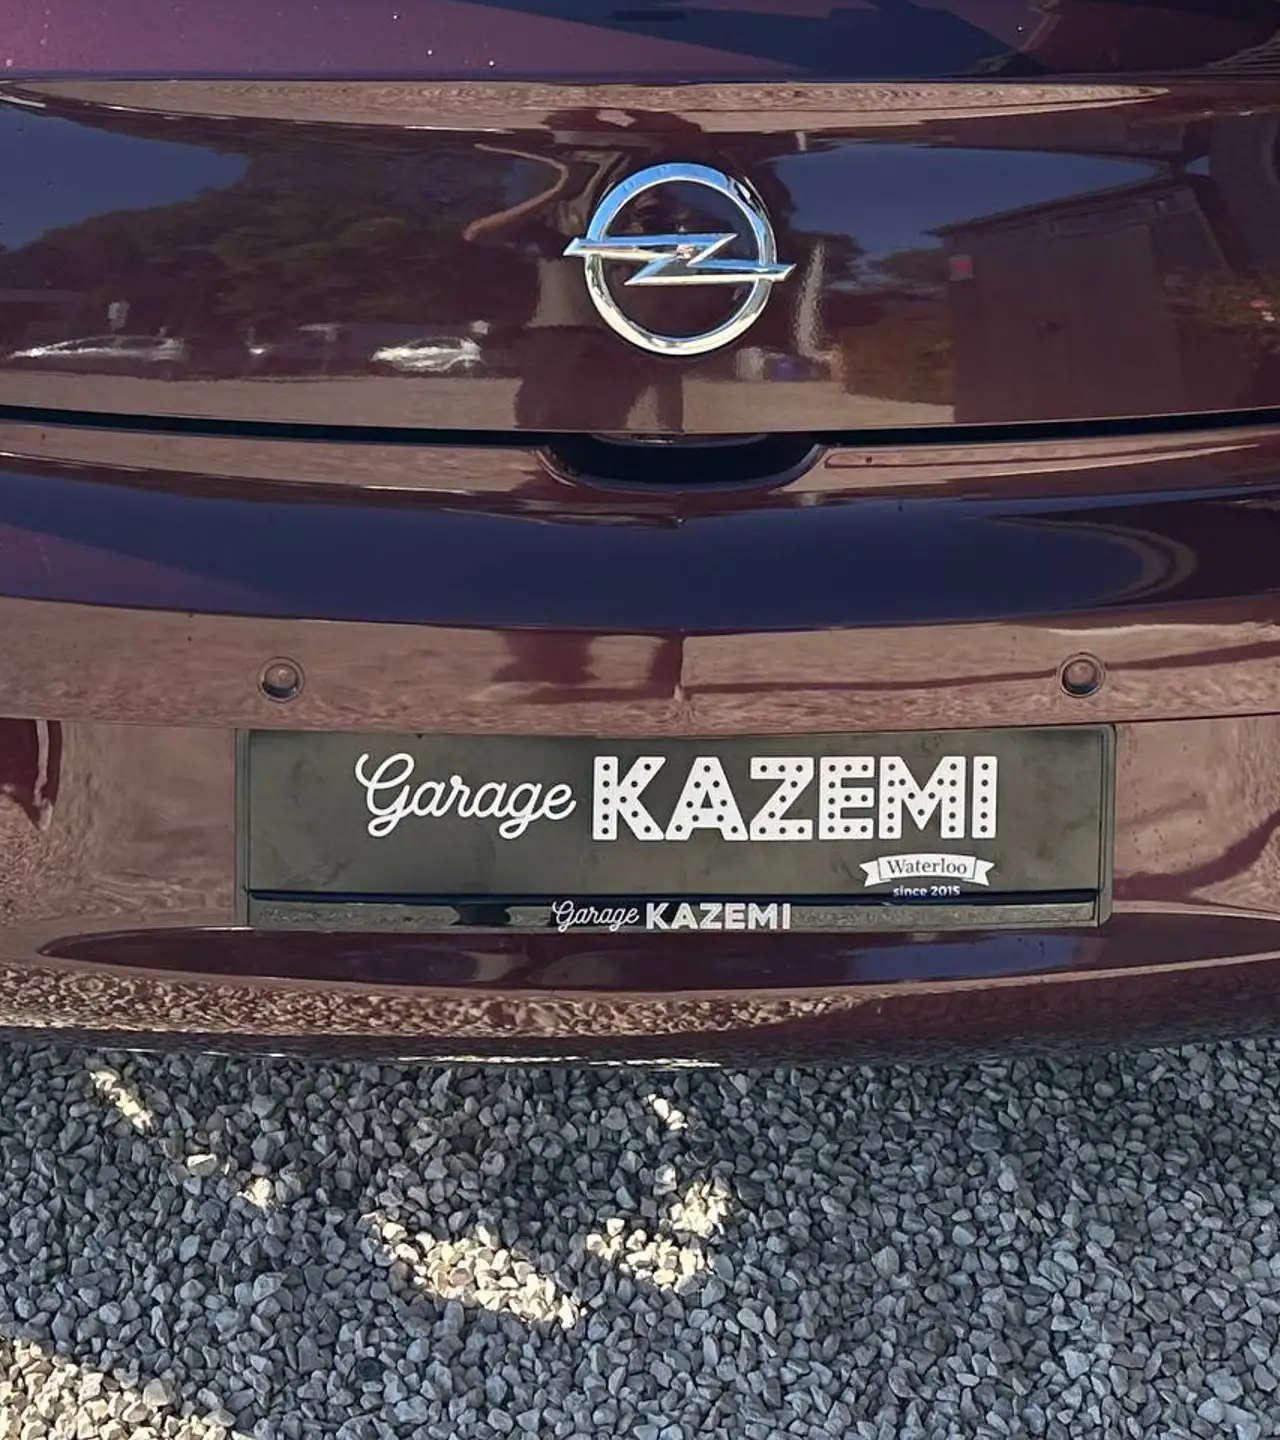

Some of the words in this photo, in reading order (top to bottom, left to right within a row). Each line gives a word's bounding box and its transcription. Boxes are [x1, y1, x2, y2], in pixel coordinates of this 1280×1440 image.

[355, 752, 577, 840] Garage
[592, 756, 998, 841] KAZEMI
[887, 858, 967, 874] Waterloo
[893, 884, 928, 897] since
[930, 885, 961, 897] 2015
[552, 900, 640, 933] Garage
[645, 902, 791, 930] KAZEMI
